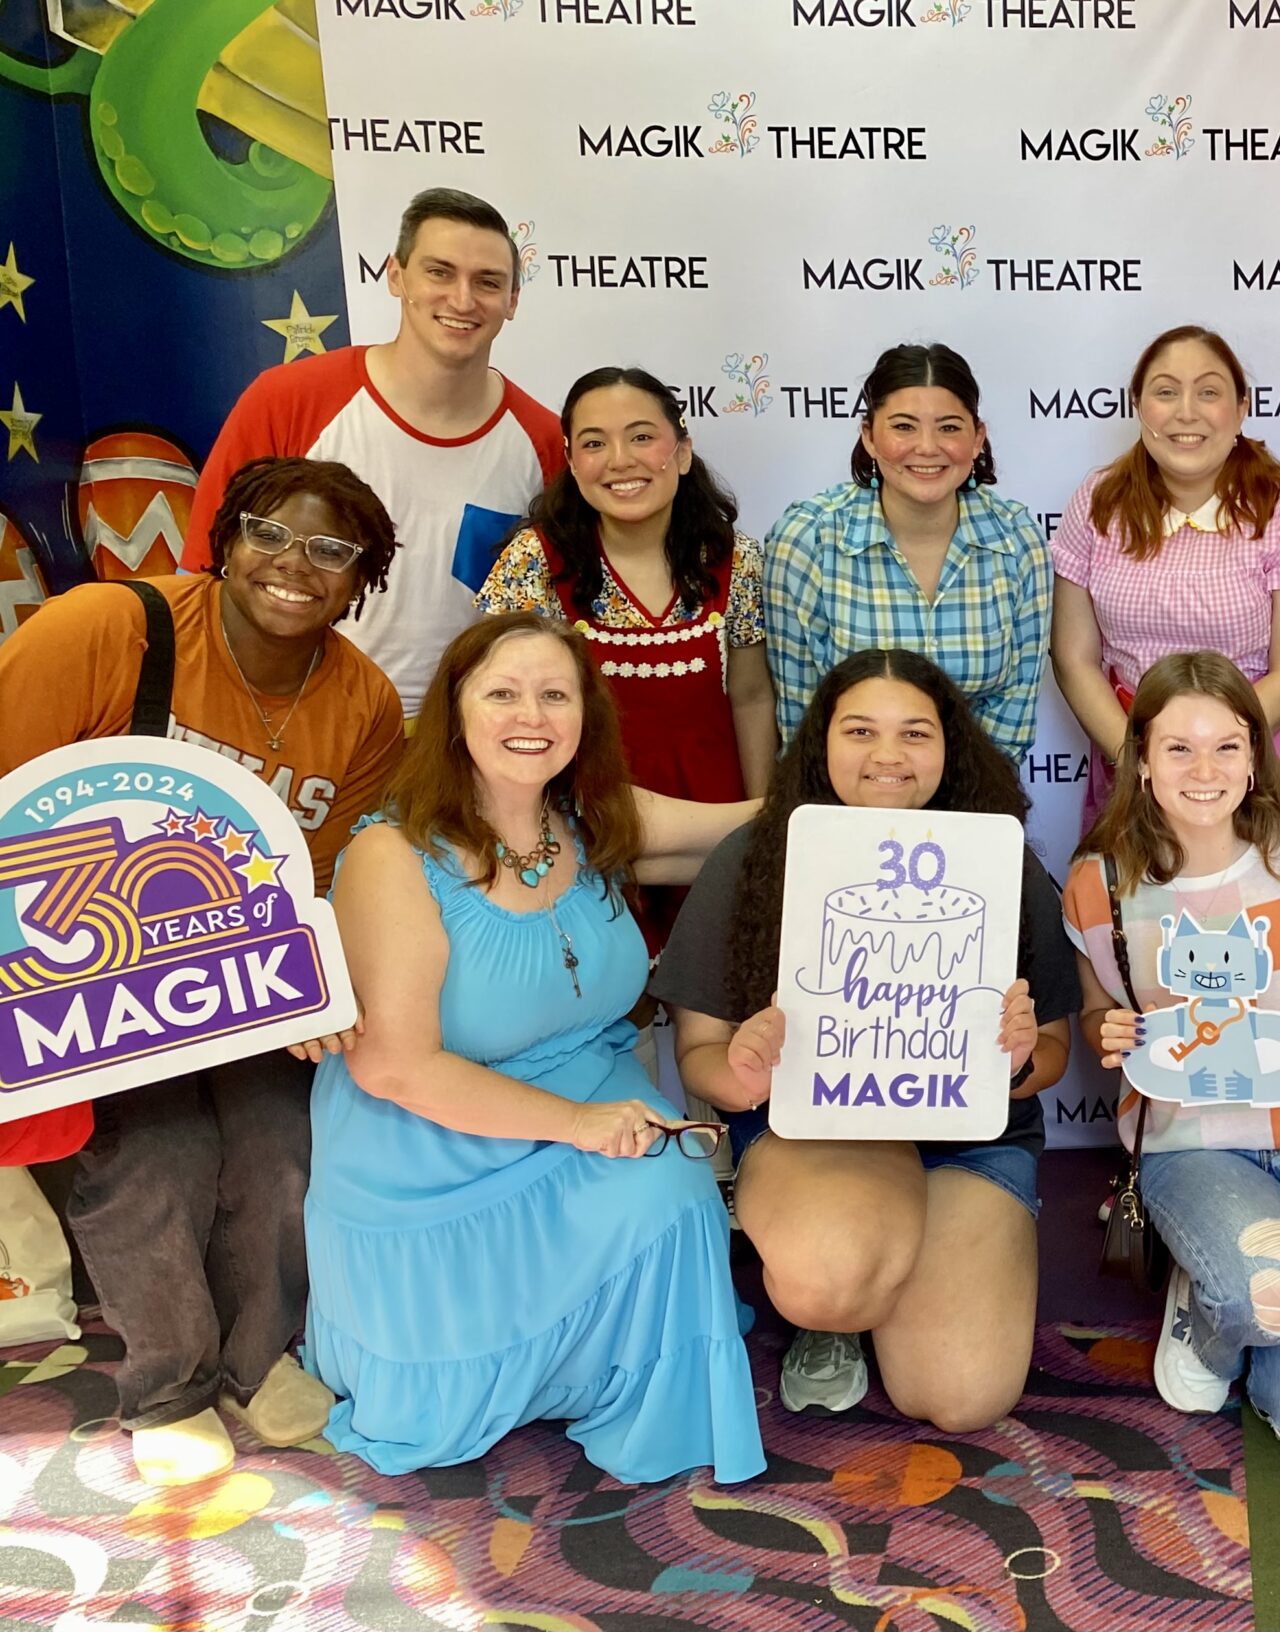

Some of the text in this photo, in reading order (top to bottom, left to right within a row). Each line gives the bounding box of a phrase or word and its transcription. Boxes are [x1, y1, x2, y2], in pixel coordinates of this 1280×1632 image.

[794, 0, 1135, 29] MAGIK THEATRE
[578, 125, 926, 160] MAGIK THEATRE
[1020, 129, 1141, 161] MAGIK
[547, 255, 709, 288] THEATRE
[802, 259, 1142, 291] MAGIK THEATRE
[780, 386, 867, 418] THEA
[24, 771, 195, 825] 1994-2024
[876, 839, 946, 891] 30
[142, 892, 278, 948] YEARS of
[13, 943, 304, 1067] MAGIK
[843, 946, 960, 1029] happy
[816, 1015, 969, 1073] Birthday
[812, 1072, 970, 1108] MAGIK
